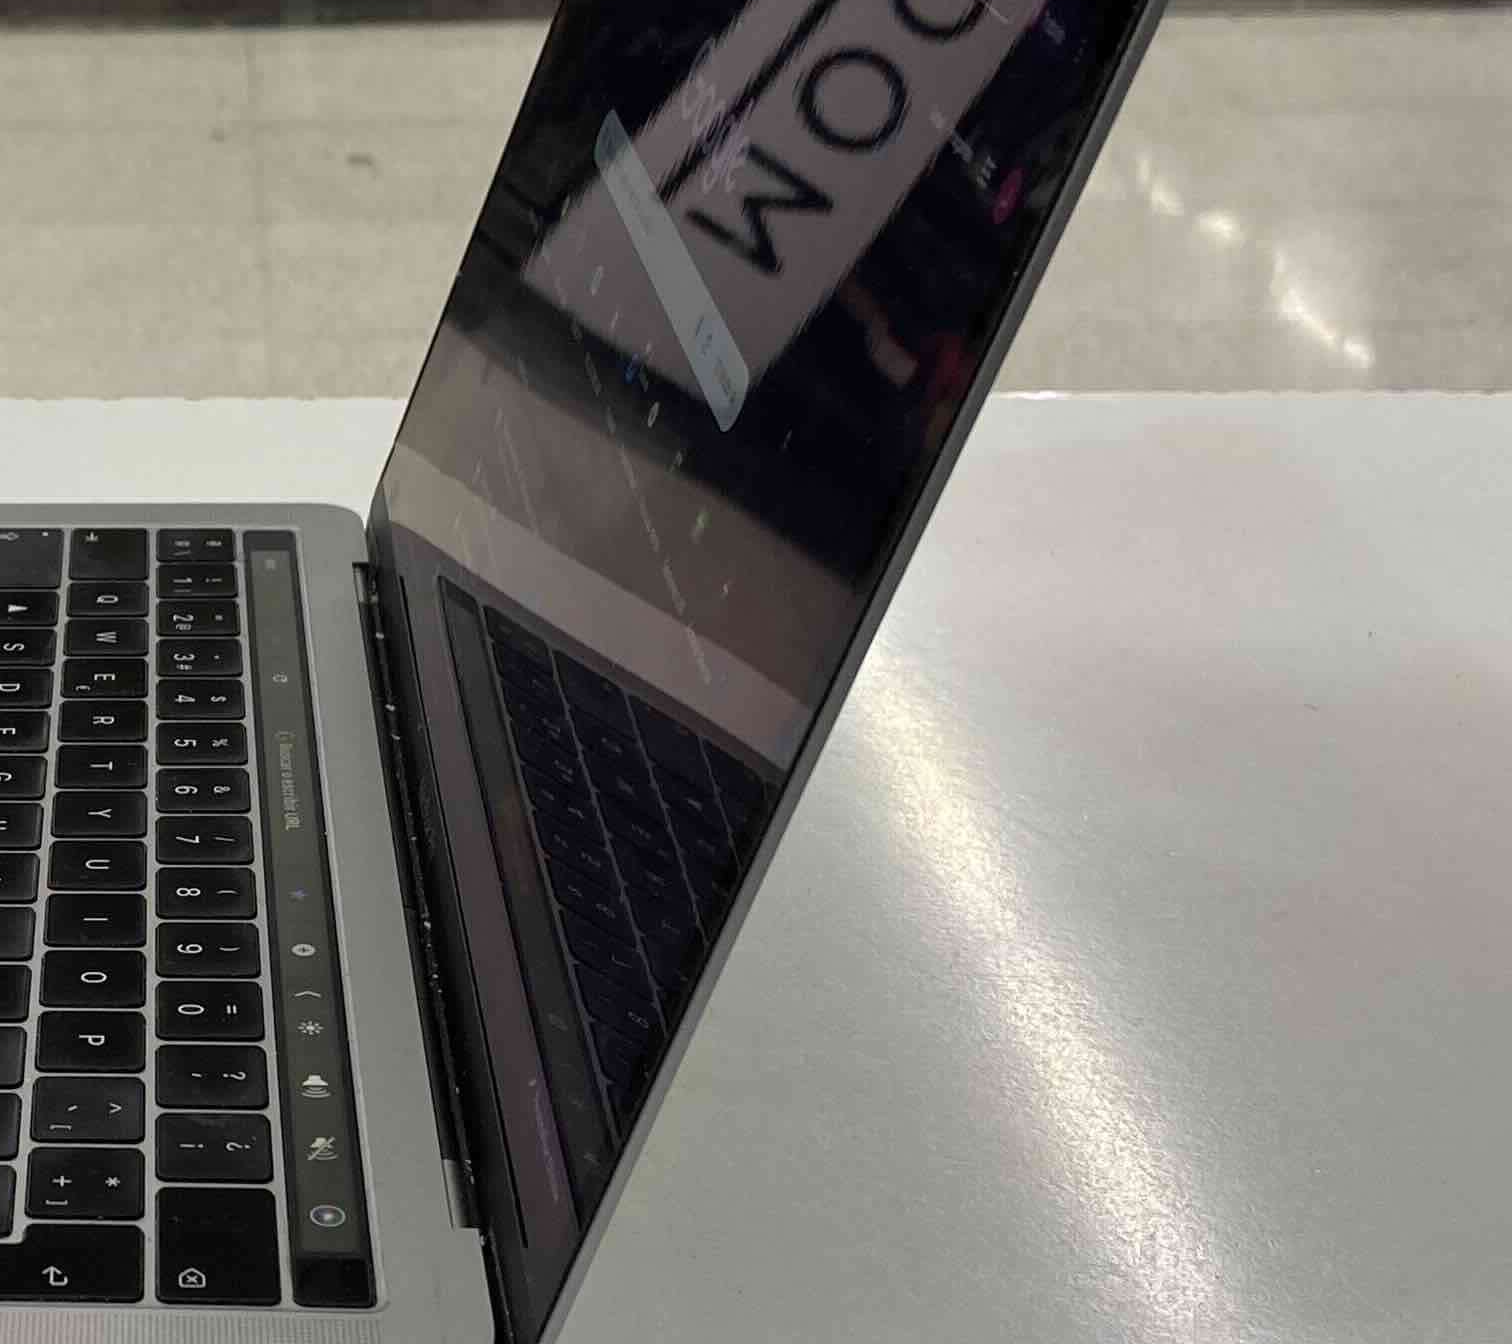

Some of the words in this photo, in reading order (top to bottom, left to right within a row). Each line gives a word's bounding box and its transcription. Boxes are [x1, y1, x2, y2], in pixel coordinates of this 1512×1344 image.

[172, 614, 194, 622] 2
[97, 632, 116, 642] W
[3, 643, 24, 651] S
[173, 653, 195, 661] 3
[93, 673, 116, 681] E
[210, 695, 227, 703] $
[91, 762, 112, 770] T
[175, 786, 197, 794] 6
[88, 809, 111, 817] Y
[86, 860, 109, 869] U
[176, 888, 200, 896] 8
[177, 944, 202, 953] 9
[81, 972, 107, 983] O
[178, 1005, 204, 1014] 0
[79, 1035, 104, 1045] P
[224, 1072, 245, 1080] ?
